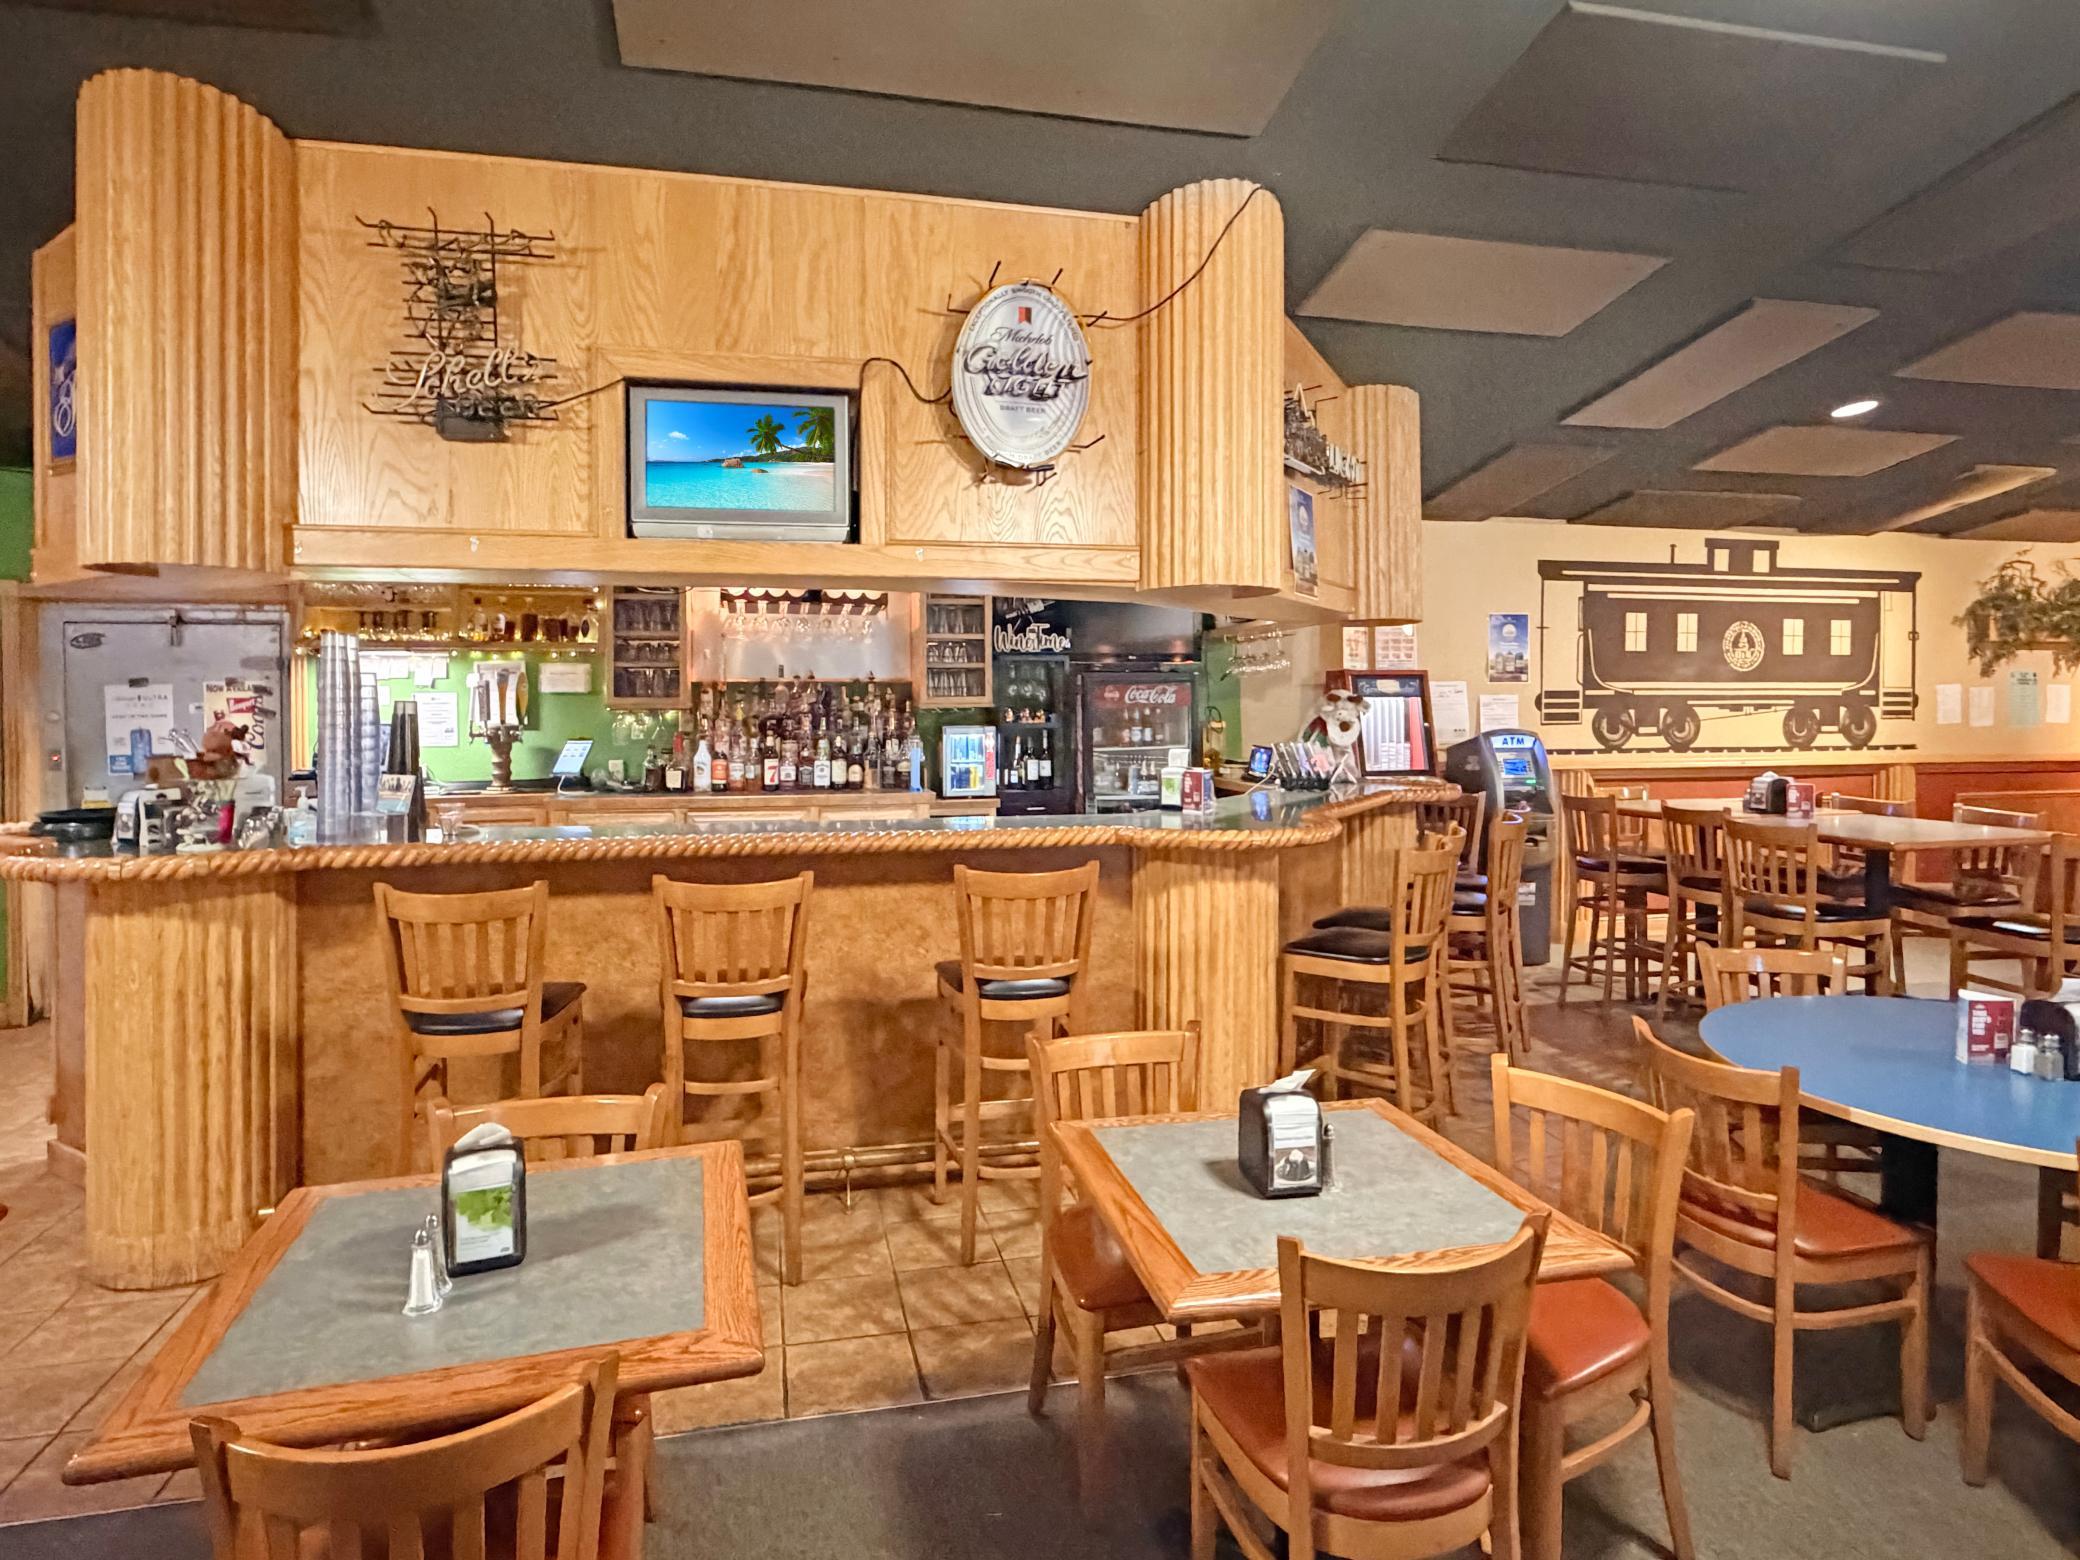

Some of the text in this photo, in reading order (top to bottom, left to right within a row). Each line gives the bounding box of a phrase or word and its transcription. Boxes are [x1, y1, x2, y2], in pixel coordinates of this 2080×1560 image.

[991, 327, 1053, 345] Michelob
[964, 345, 1088, 380] Golden
[1000, 405, 1046, 414] DRAFT BEER
[206, 684, 224, 693] NOW
[1502, 736, 1525, 746] ATM
[767, 765, 778, 784] 7
